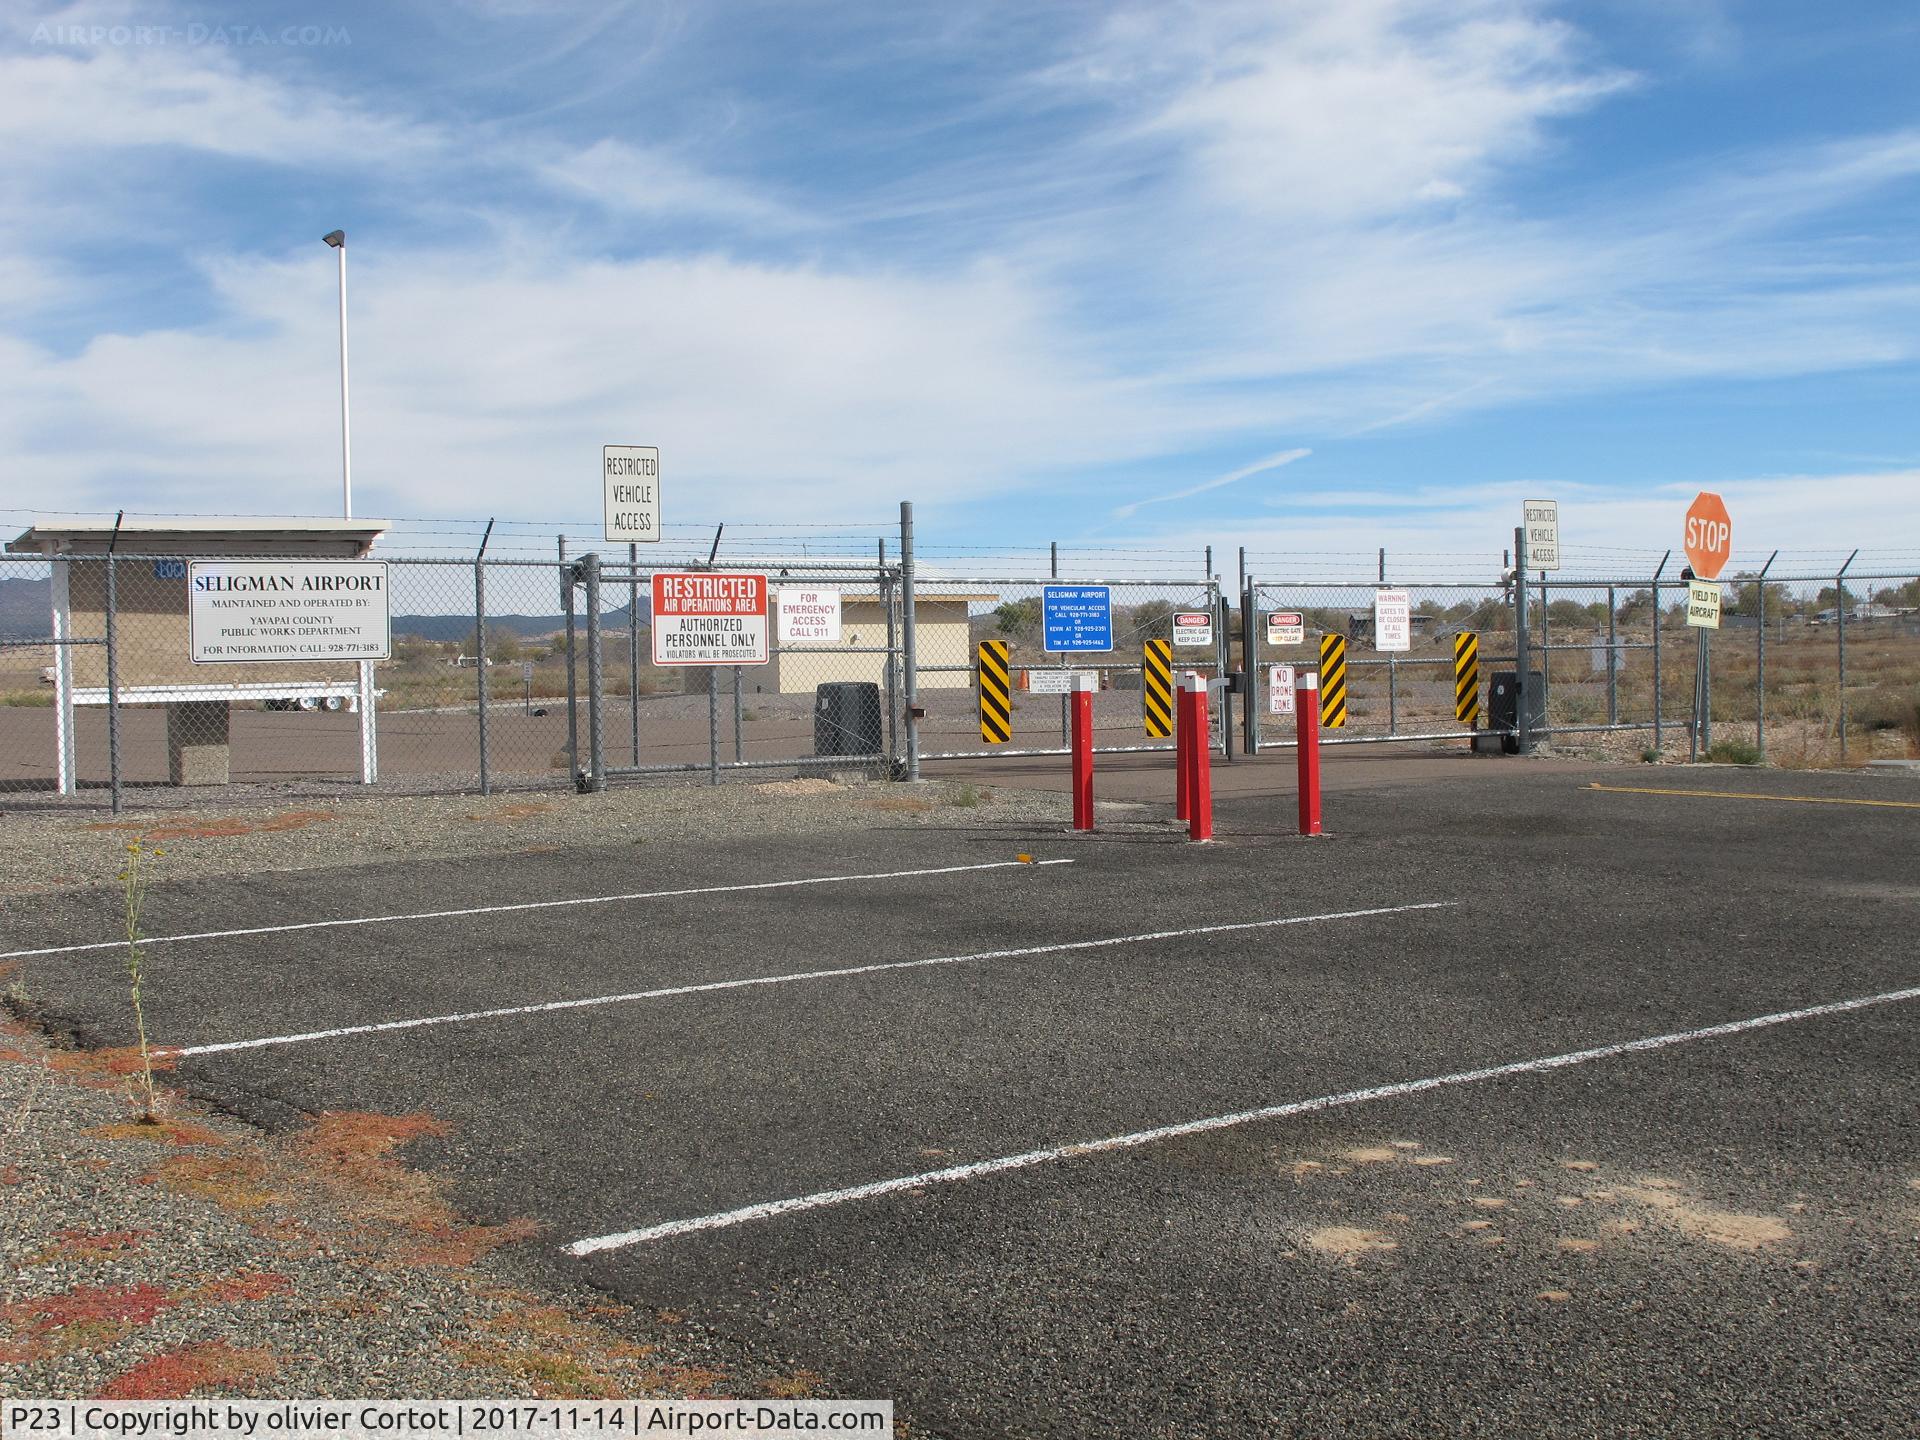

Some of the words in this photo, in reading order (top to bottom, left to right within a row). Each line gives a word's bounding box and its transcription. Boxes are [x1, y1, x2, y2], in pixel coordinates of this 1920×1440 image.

[607, 457, 656, 476] RESTRICTED
[613, 485, 652, 503] VEHICLE
[614, 512, 651, 530] ACCESS
[1526, 508, 1556, 522] RESTRICTED
[1531, 529, 1554, 542] VEHICLE
[1687, 517, 1728, 553] STOP
[1532, 549, 1555, 562] ACCESS
[195, 576, 294, 592] SELIGMAN
[301, 575, 384, 591] AIRPORT
[663, 578, 757, 598] RESTRICTED
[800, 593, 818, 603] FOR
[1047, 591, 1078, 599] SELIGMAN
[1080, 591, 1106, 599] AIRPORT
[1692, 590, 1708, 601] YIELD
[1710, 592, 1718, 603] TO
[212, 600, 276, 608] MAINTAINED
[278, 600, 301, 608] AND
[304, 599, 353, 608] OPERATED
[355, 599, 371, 607] BY:
[664, 599, 678, 612] AIR
[681, 599, 733, 612] OPERATIONS
[735, 599, 757, 612] AREA
[783, 604, 835, 614] EMERGENCY
[1689, 606, 1718, 619] AIRCRAFT
[250, 616, 290, 625] YAVAPAI
[292, 616, 334, 624] COUNTY
[680, 618, 743, 632] AUTHORIZED
[792, 616, 826, 625] ACCESS
[221, 628, 257, 637] PUBLIC
[260, 628, 296, 636] WORKS
[298, 627, 361, 635] DEPARTMENT
[789, 627, 812, 637] CALL
[814, 627, 828, 637] 911
[665, 634, 727, 647] PERSONNEL
[731, 633, 756, 647] ONLY
[203, 646, 224, 655] FOR
[226, 645, 297, 654] INFORMATION
[300, 644, 326, 653] CALL:
[328, 644, 380, 652] 928-771-3183
[666, 650, 697, 659] VIOLATORS
[698, 650, 712, 659] WILL
[713, 650, 721, 658] BE
[722, 649, 757, 658] PROSECUTED
[1276, 670, 1287, 682] NO
[1272, 686, 1292, 696] DRONE
[1274, 699, 1291, 709] ZONE
